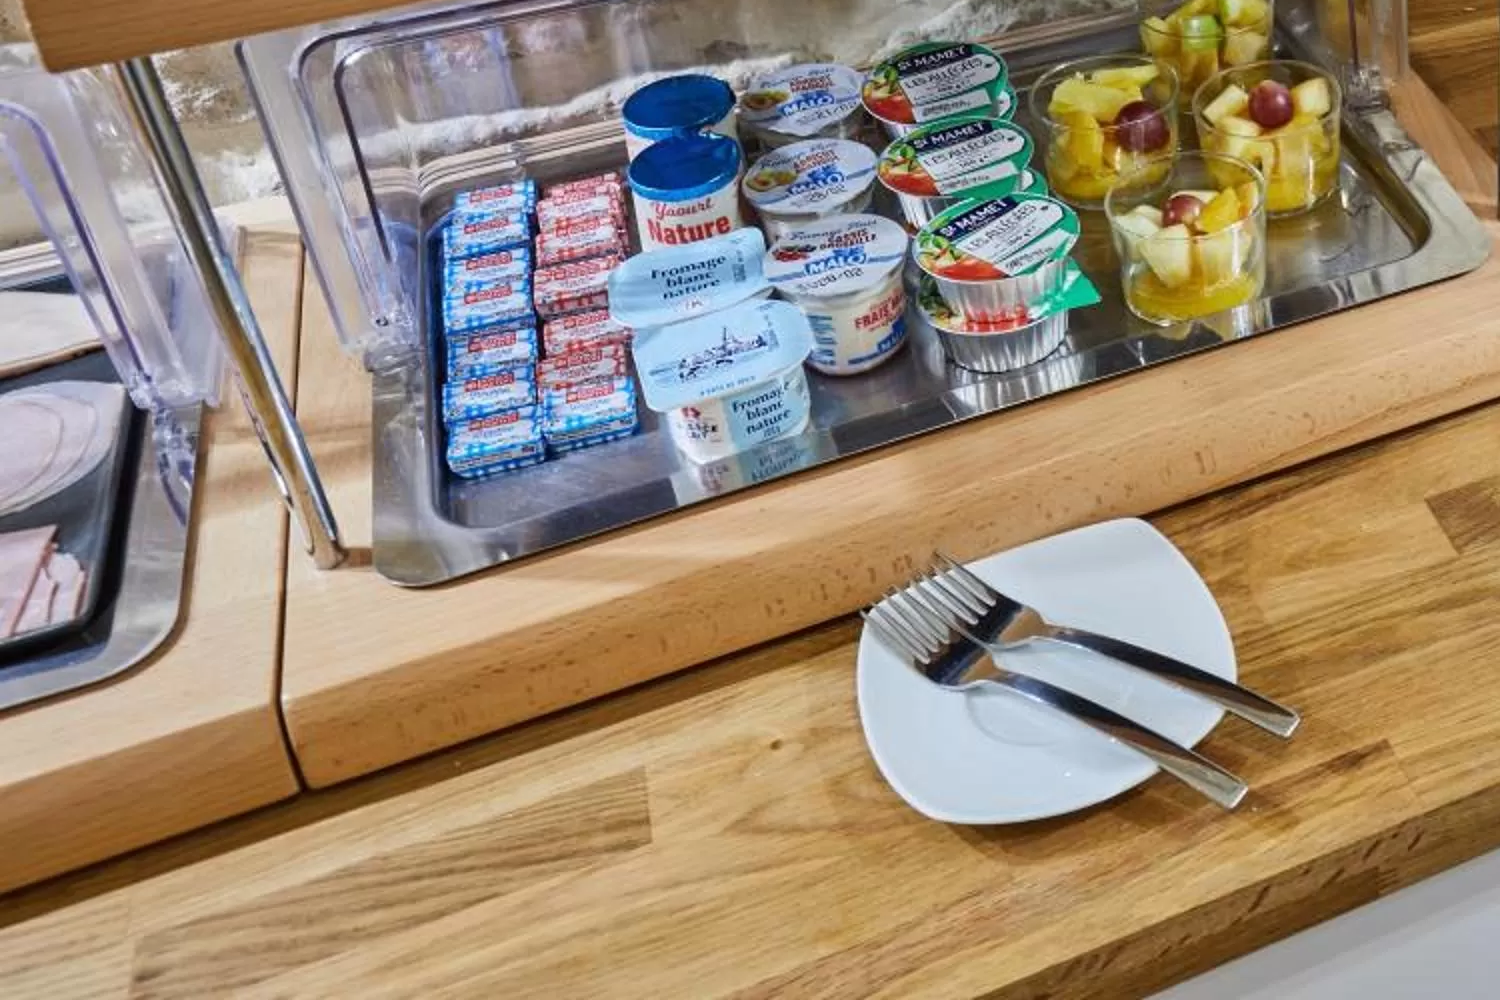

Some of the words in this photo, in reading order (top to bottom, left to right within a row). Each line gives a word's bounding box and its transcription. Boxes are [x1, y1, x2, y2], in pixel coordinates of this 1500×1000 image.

[783, 94, 833, 116] MALO
[931, 122, 985, 143] MAMET
[655, 198, 715, 219] Yaourt
[955, 200, 1008, 229] MAMET
[647, 215, 731, 245] Nature
[651, 255, 726, 280] Fromage
[808, 252, 866, 276] MALO
[663, 278, 721, 300] nature
[667, 270, 714, 289] blanc
[732, 380, 791, 413] Fromage
[746, 398, 784, 421] blanc
[746, 408, 792, 435] nature
